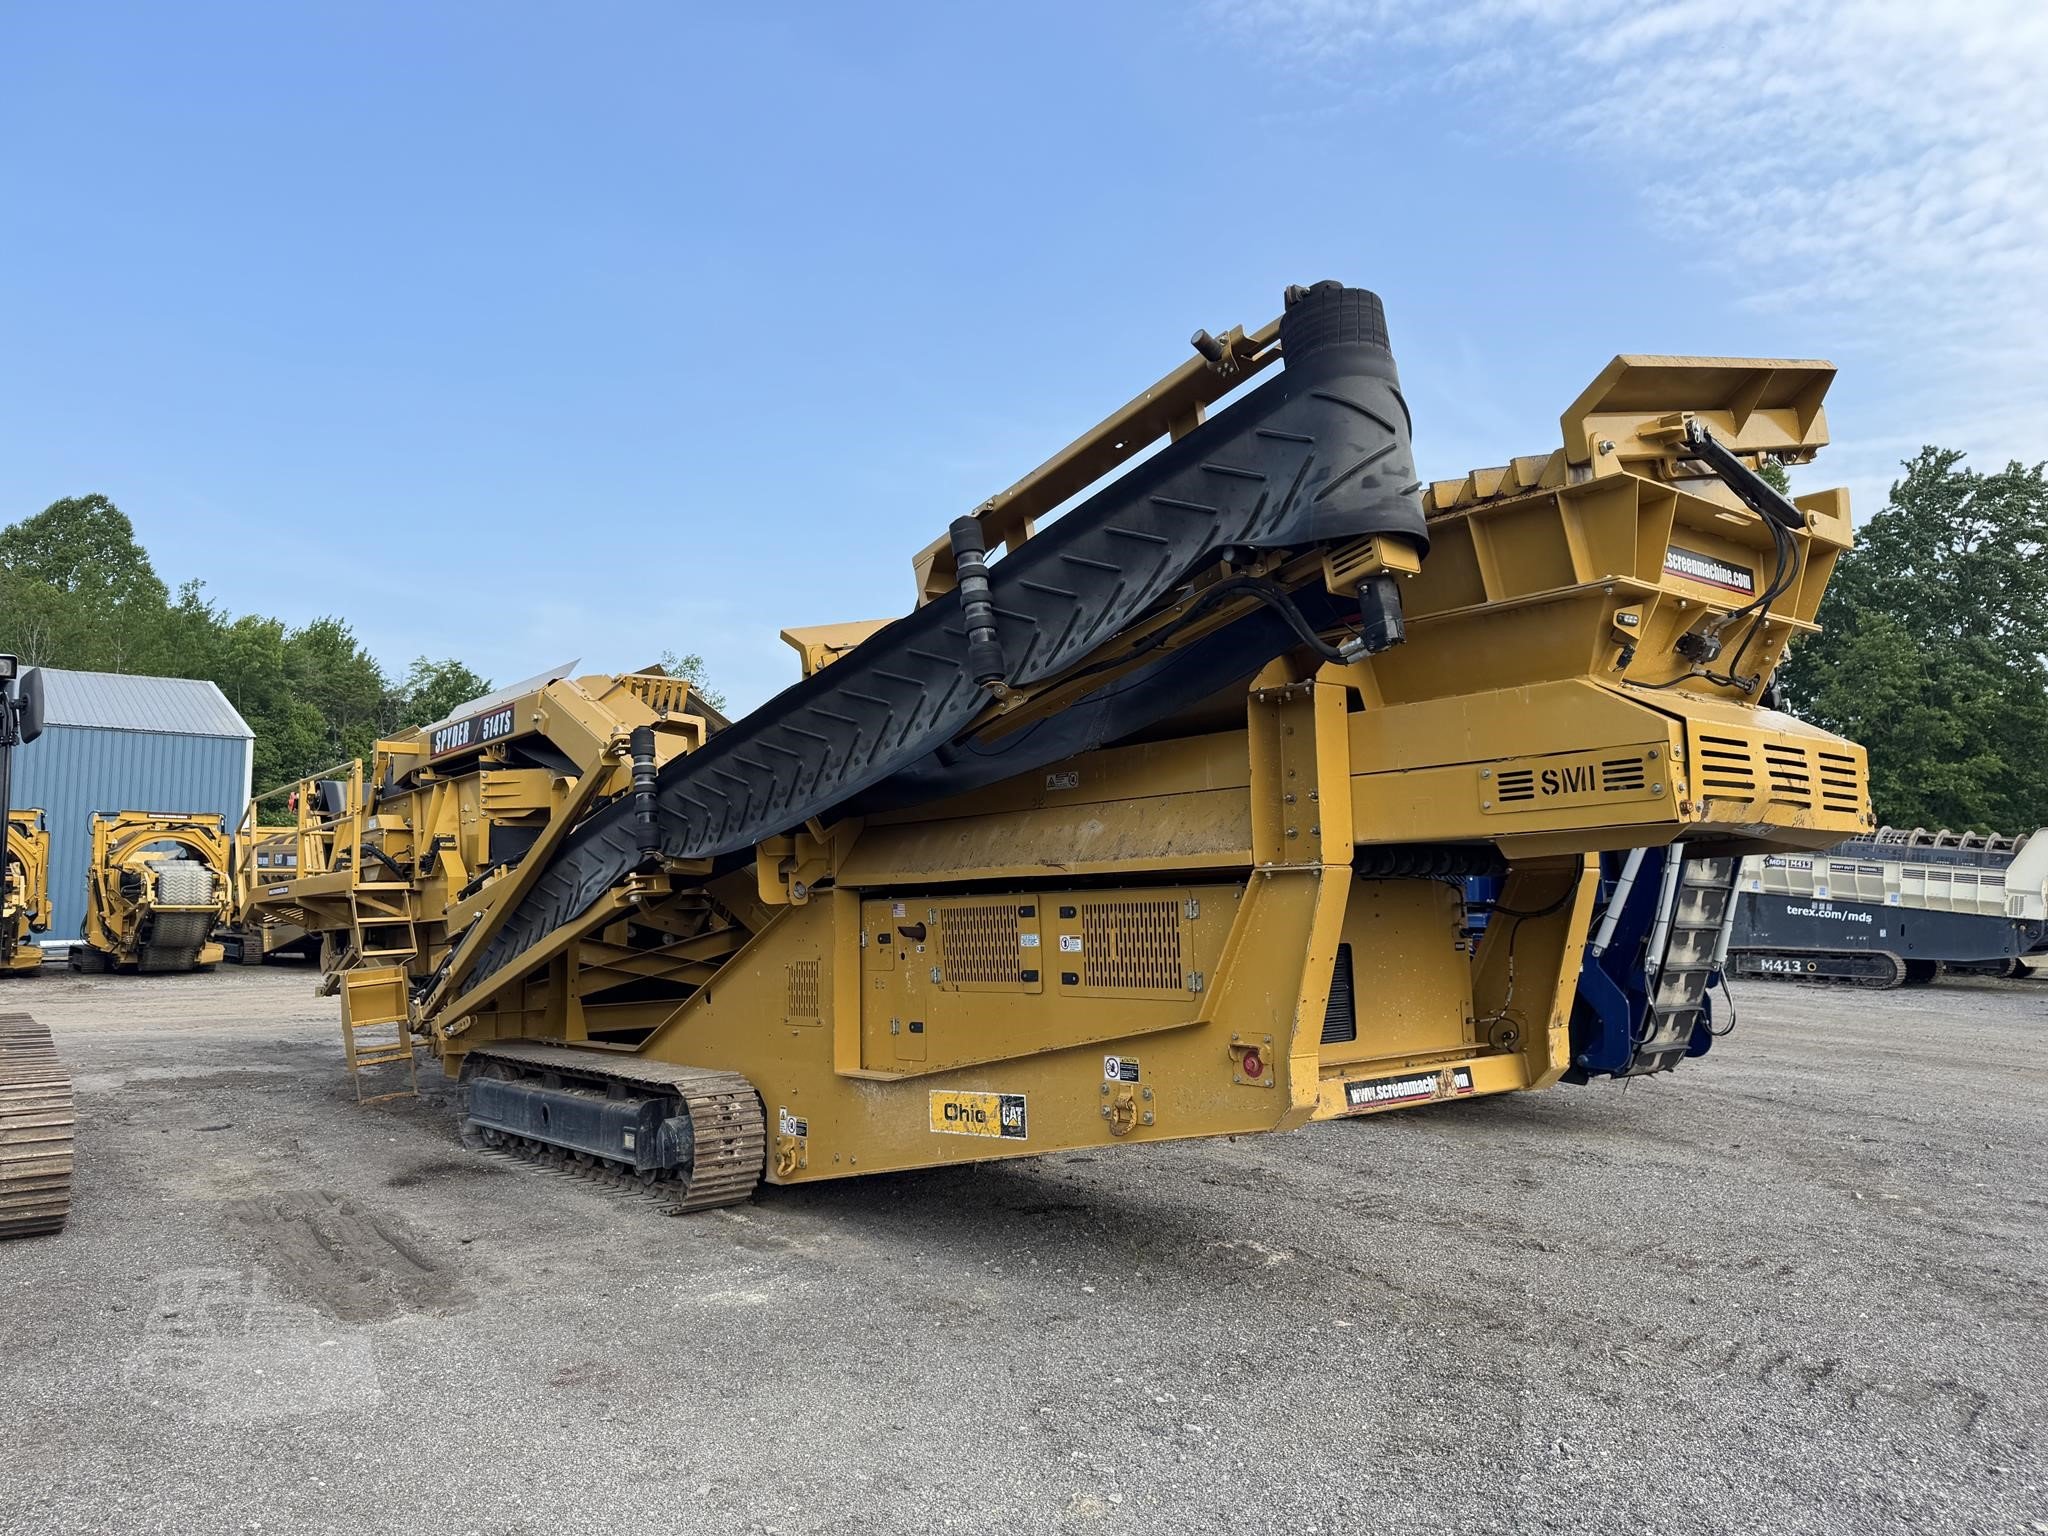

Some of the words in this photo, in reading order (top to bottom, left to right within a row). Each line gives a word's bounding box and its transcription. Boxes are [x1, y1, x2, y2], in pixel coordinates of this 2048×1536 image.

[435, 720, 470, 754] SPYDER
[482, 710, 512, 740] 514TS
[1541, 765, 1596, 796] SMI
[1769, 858, 1786, 867] MDS
[1786, 905, 1873, 923] terex.com/mds
[1761, 959, 1802, 972] M413
[944, 1103, 986, 1123] Ohio
[1002, 1106, 1023, 1127] CAT
